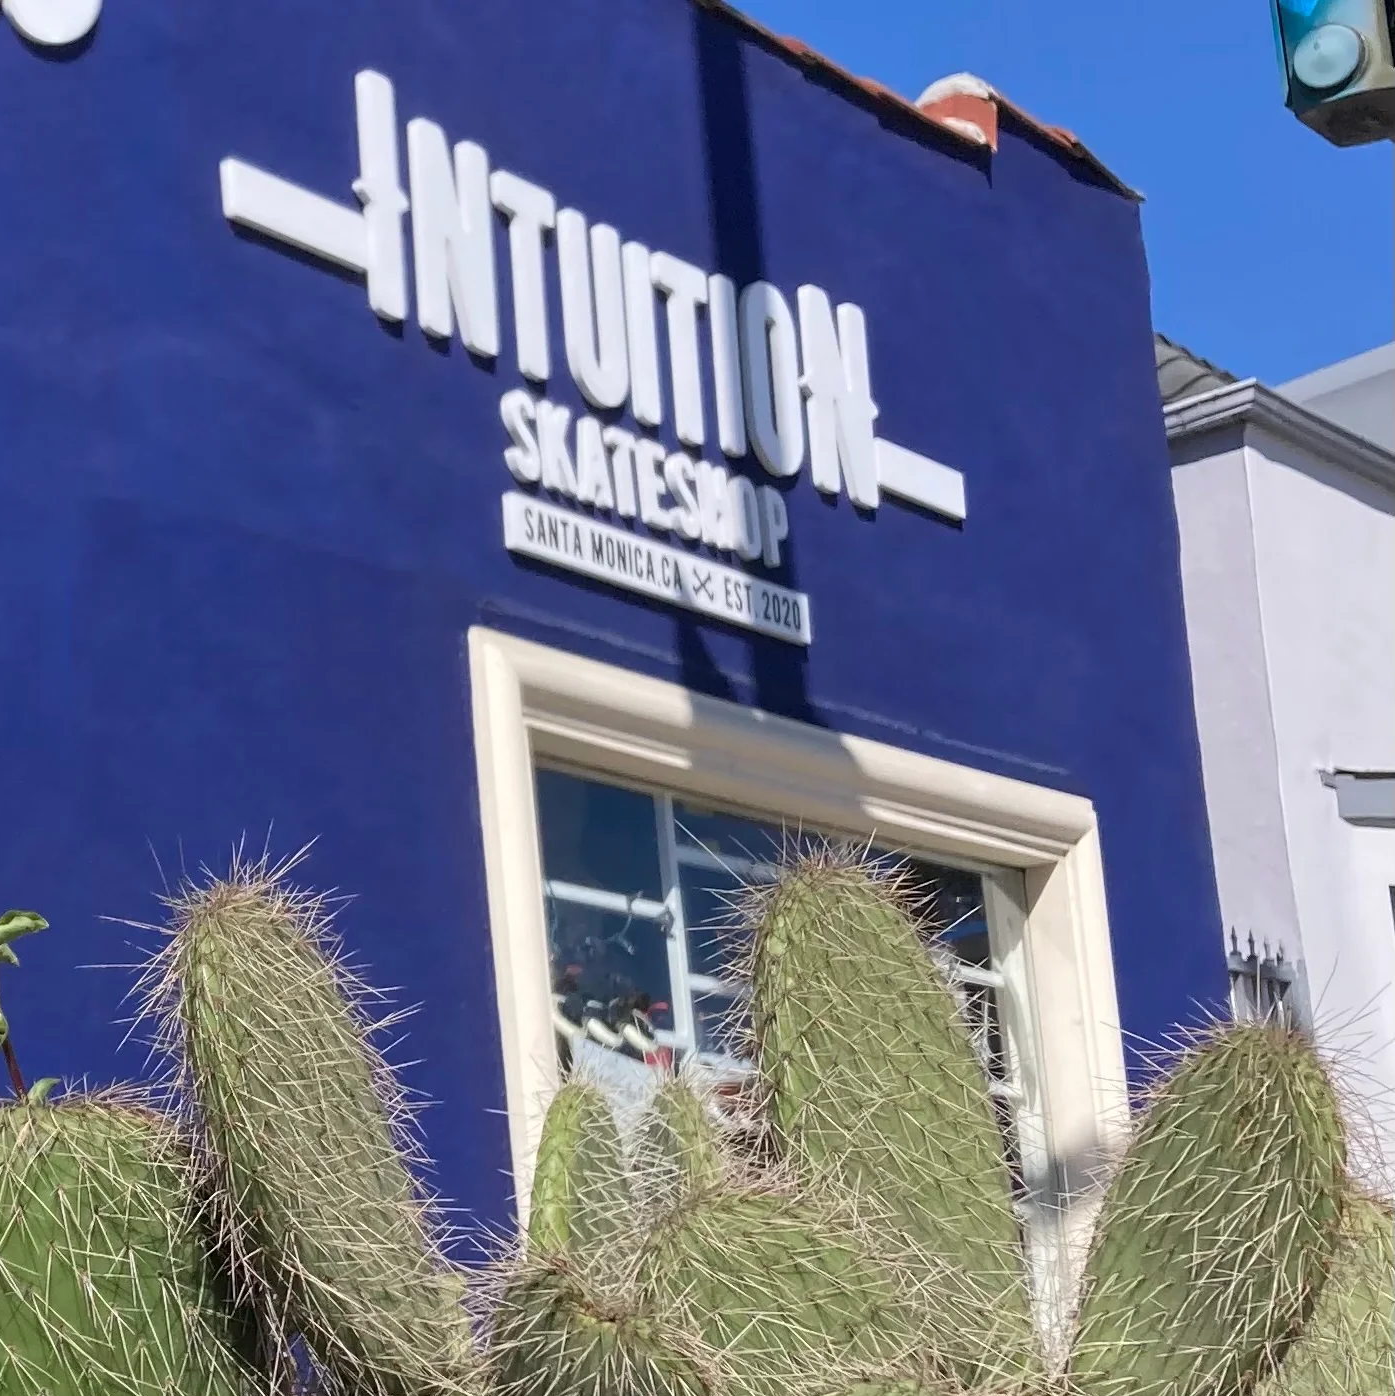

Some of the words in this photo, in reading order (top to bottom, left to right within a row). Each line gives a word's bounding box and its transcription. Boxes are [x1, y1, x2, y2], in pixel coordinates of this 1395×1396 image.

[353, 68, 878, 510] INTUITION
[500, 389, 789, 568] SKATESHOP
[524, 506, 584, 560] SANTA
[762, 591, 802, 631] 2020
